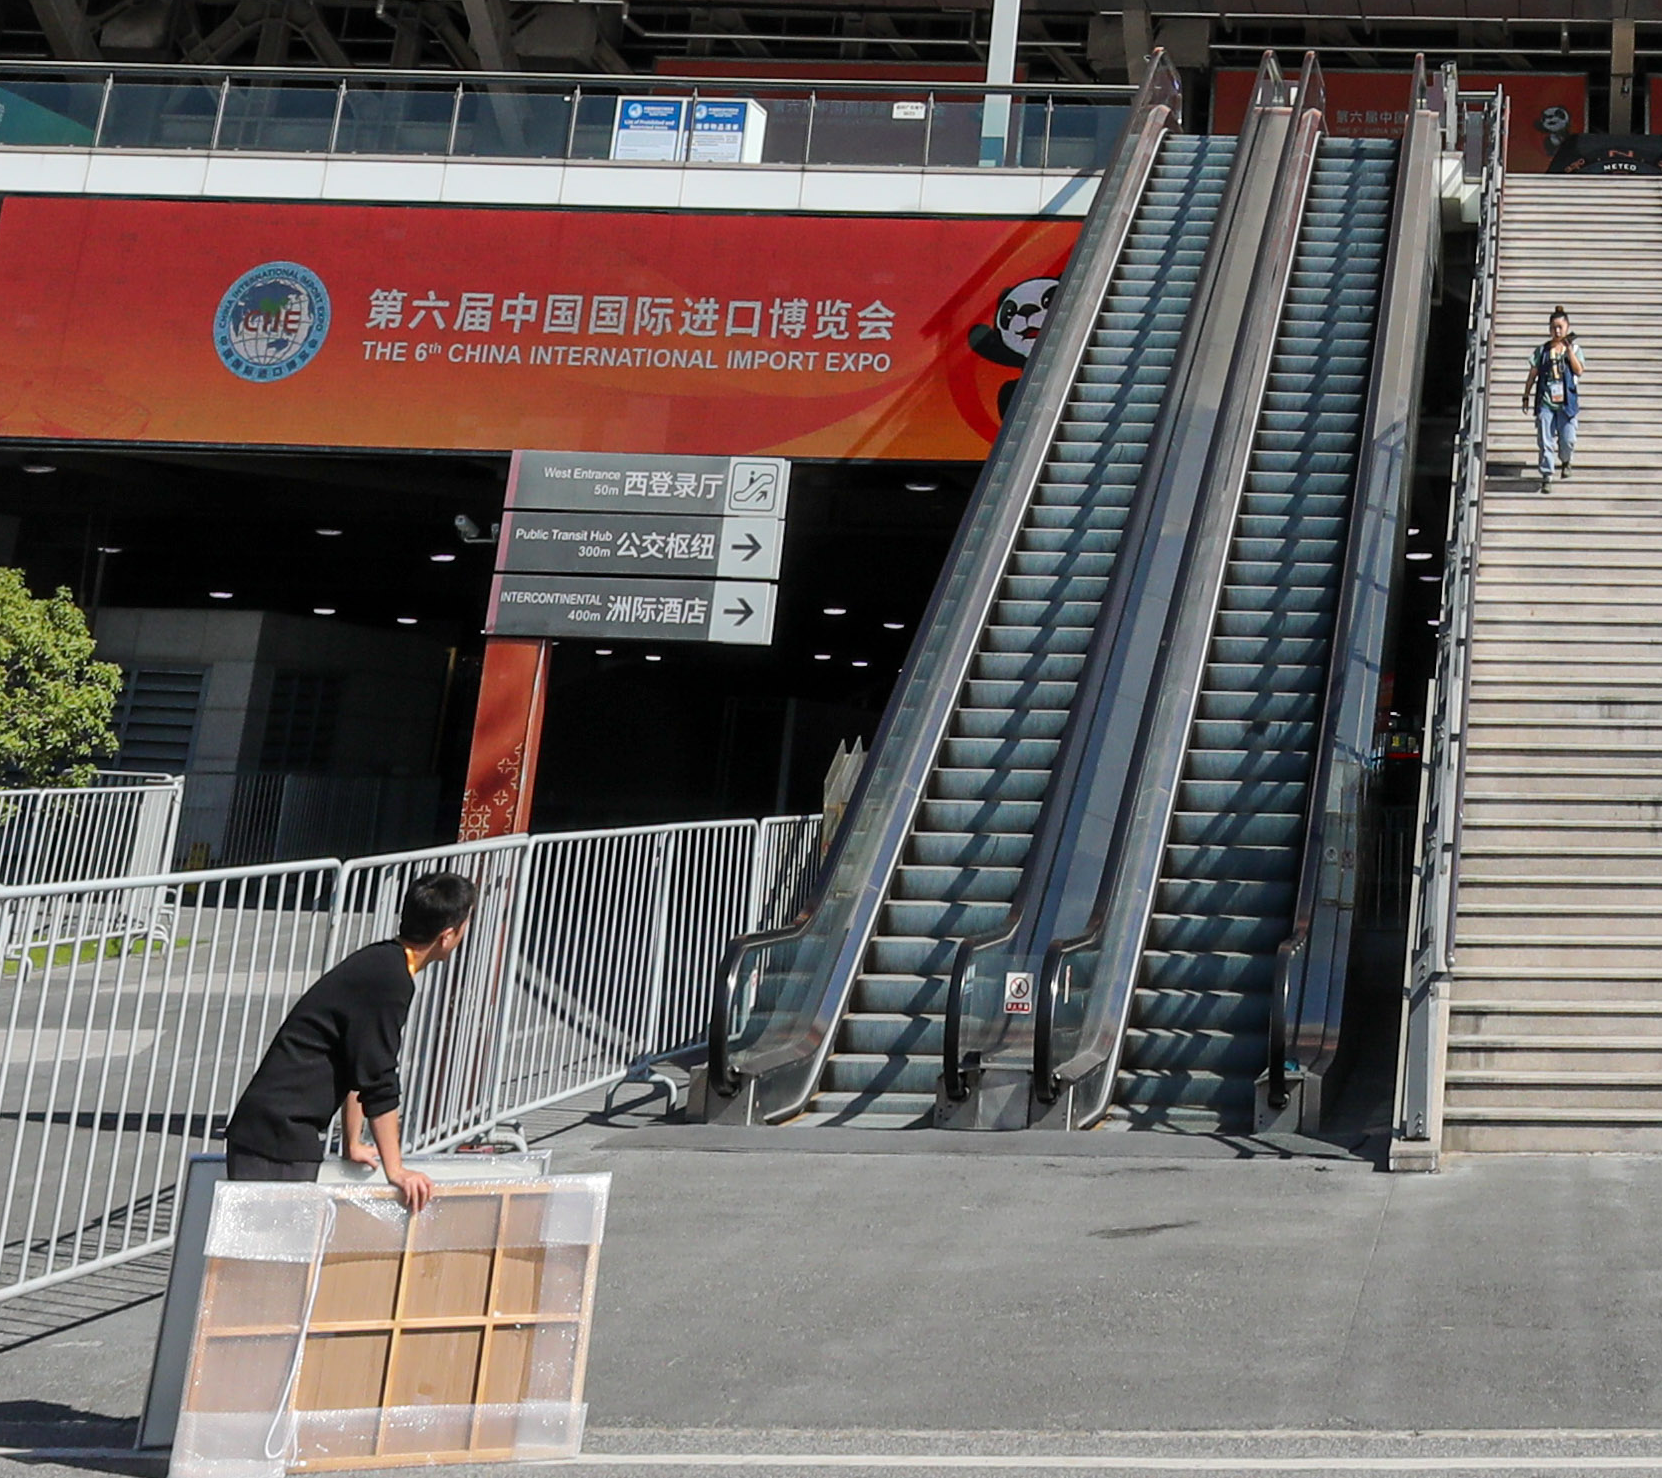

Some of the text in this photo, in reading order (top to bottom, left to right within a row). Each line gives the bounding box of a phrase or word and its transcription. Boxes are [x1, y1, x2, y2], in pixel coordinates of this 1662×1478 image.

[365, 288, 895, 341] 第六届中国国际进口博览会
[362, 341, 891, 373] THE 6th CHINA INTERNATIONAL IMPORT EXPO
[544, 467, 621, 481] West Entrance
[594, 485, 619, 495] 50m
[623, 470, 724, 499] 西登录厅
[515, 528, 613, 542] Public Transit Hub
[578, 546, 611, 558] 300m
[616, 531, 715, 560] 公交枢纽
[500, 591, 602, 606] INTERCONTINENTAL
[568, 609, 601, 622] 400m
[605, 594, 709, 625] 洲际酒店
